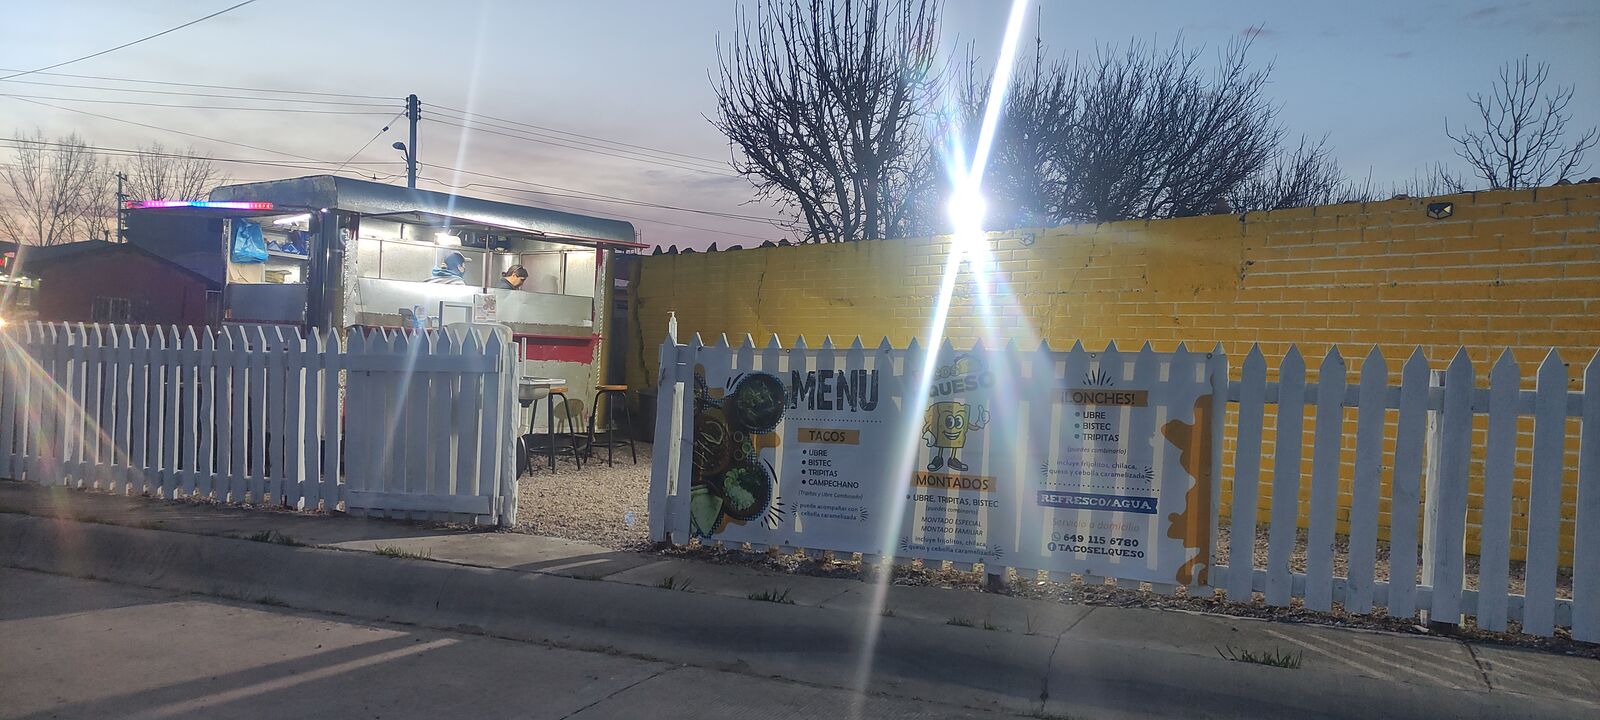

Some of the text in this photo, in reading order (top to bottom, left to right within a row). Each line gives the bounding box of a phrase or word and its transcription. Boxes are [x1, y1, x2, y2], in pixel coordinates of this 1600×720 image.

[929, 371, 996, 397] QUESO
[790, 369, 879, 412] MENU
[1083, 411, 1106, 419] UBRE
[1082, 422, 1111, 430] BISTEC
[809, 430, 846, 442] TACOS
[1083, 433, 1120, 442] TRIPITAS
[808, 449, 828, 457] UBRE
[808, 459, 832, 467] BISTEC
[808, 468, 838, 477] TRIPITAS
[808, 479, 859, 489] CAMPECHANO
[916, 475, 989, 490] MONTADOS
[938, 495, 971, 506] TRIPITAS,
[972, 498, 999, 508] BISTEC
[1041, 494, 1152, 510] REFRESCO/AGUA
[921, 516, 981, 527] MONTADO ESPECIAL
[920, 526, 984, 537] MONTADO FAMILIAR
[1063, 533, 1139, 547] 649 115 6780
[1058, 543, 1145, 559] TACOSELQUESO
